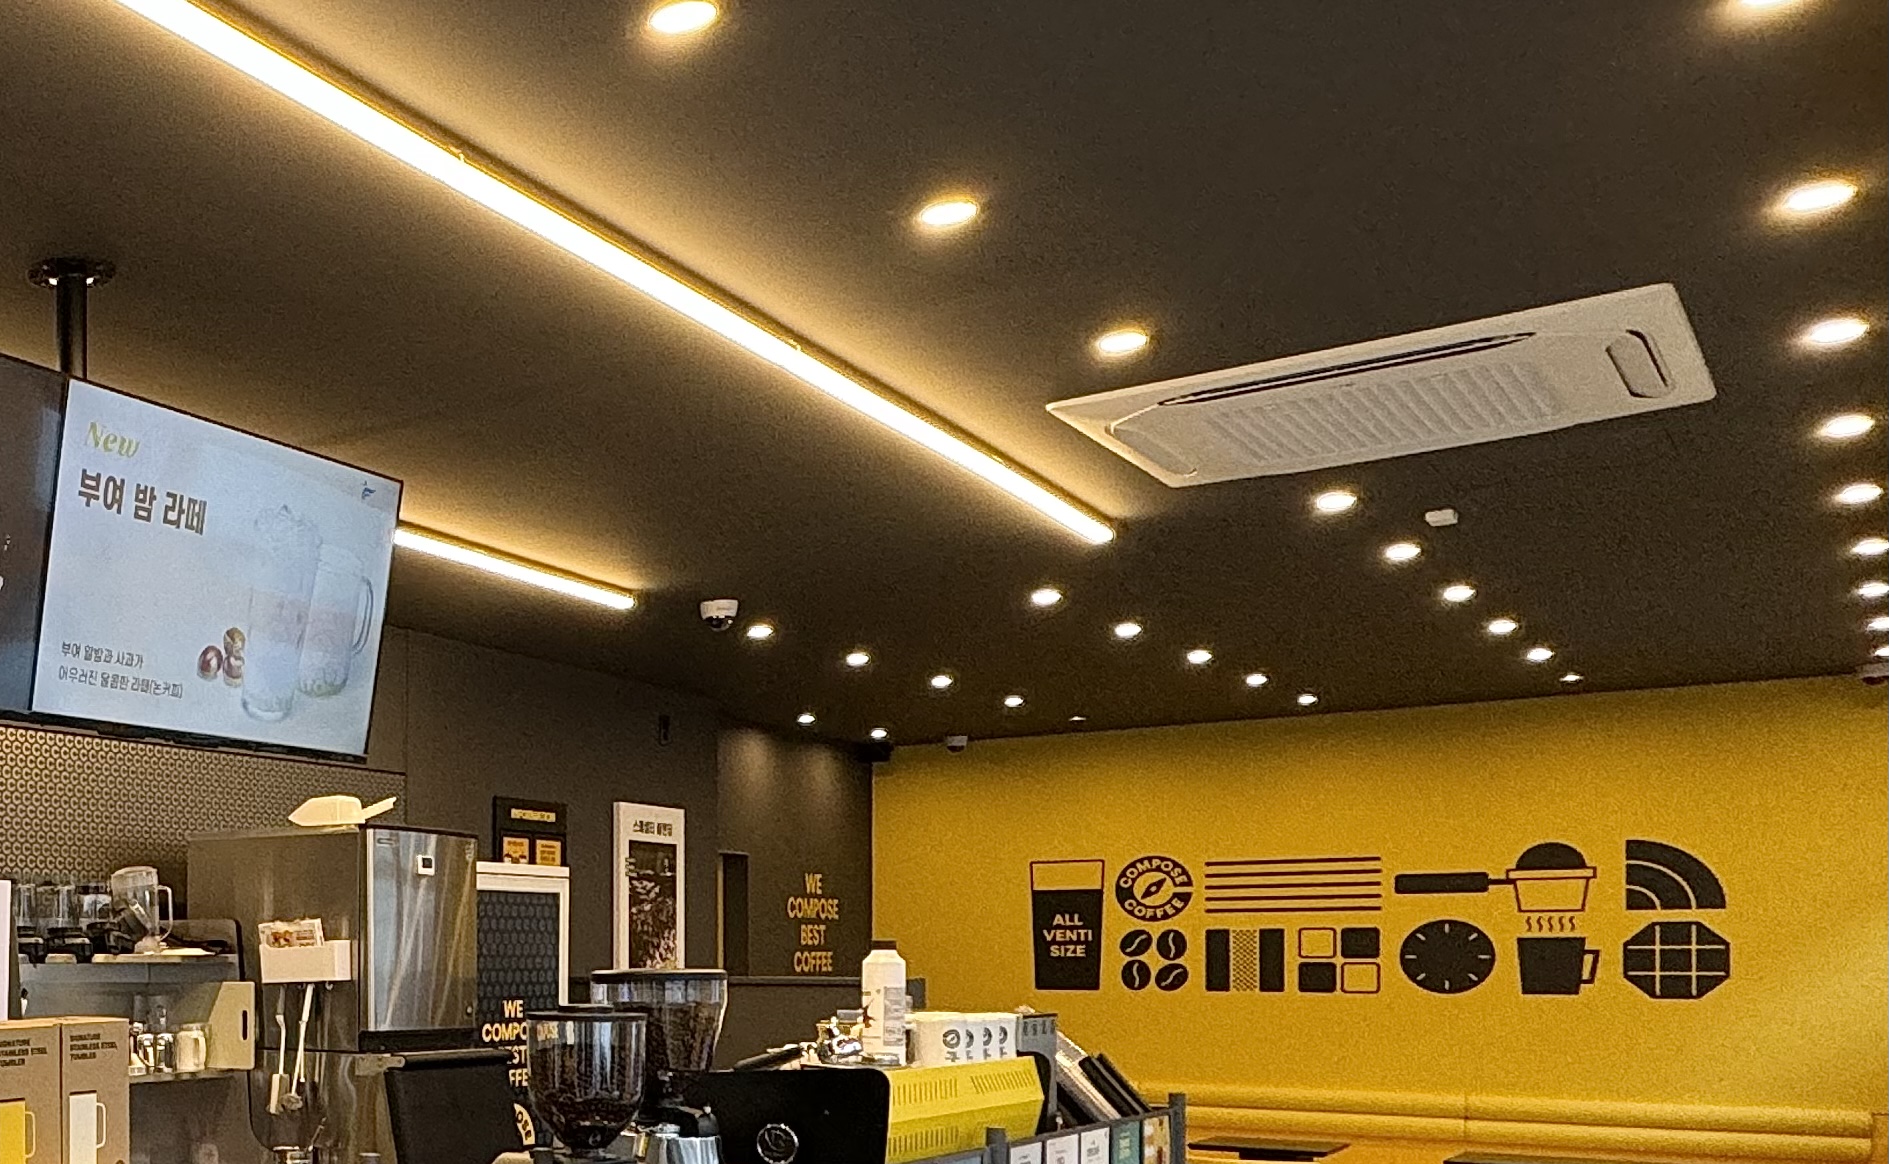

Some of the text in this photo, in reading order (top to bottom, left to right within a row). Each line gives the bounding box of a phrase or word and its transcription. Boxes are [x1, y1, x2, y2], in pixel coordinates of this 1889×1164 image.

[85, 421, 140, 458] New
[78, 468, 207, 535] 부여 밤 라떼
[59, 665, 98, 686] 어우러진
[805, 873, 822, 894] WE
[1119, 859, 1188, 888] COMPOSE
[787, 896, 839, 920] COMPOSE
[1124, 897, 1185, 919] COFFEE
[1053, 913, 1084, 926] ALL
[800, 924, 826, 946] BEST
[1043, 929, 1093, 942] VENTI
[1050, 944, 1086, 957] SIZE
[794, 951, 833, 972] COFFEE
[503, 999, 524, 1018] WE
[482, 1022, 528, 1042] COMPO
